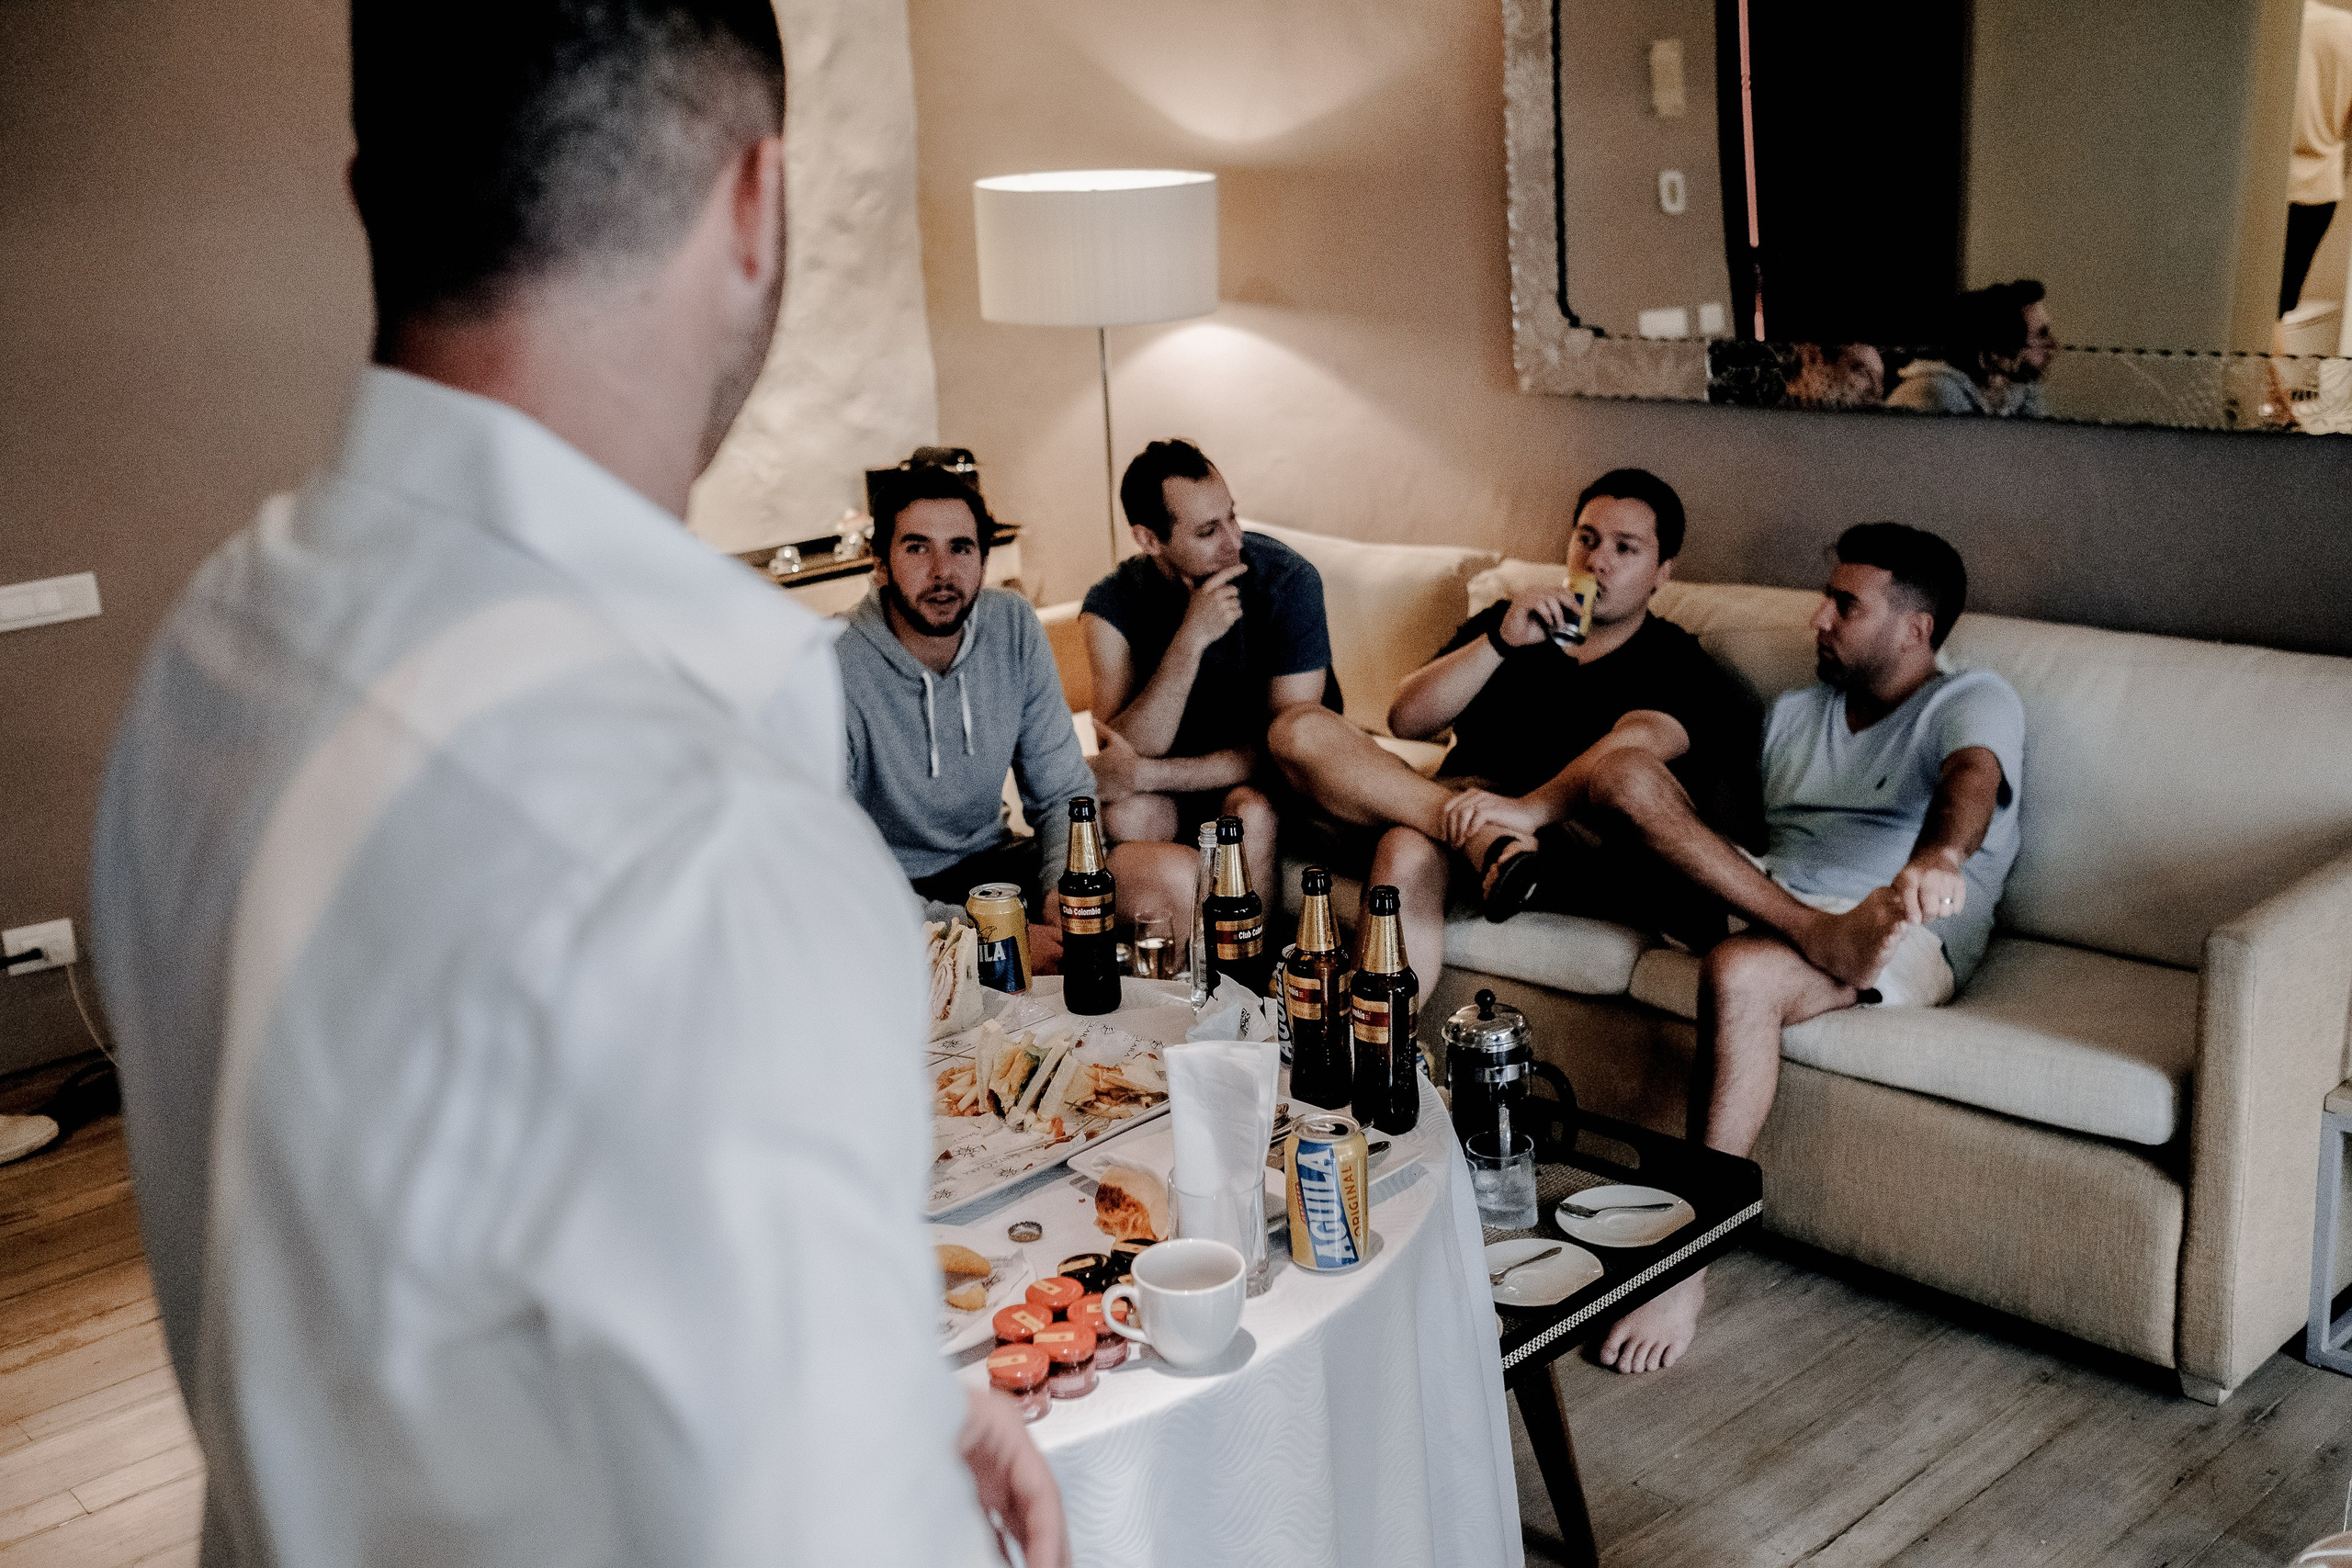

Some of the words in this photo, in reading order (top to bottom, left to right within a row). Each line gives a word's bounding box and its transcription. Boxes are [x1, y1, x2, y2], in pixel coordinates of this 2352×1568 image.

[1062, 906, 1073, 915] Club
[1074, 907, 1102, 916] Colombia
[1238, 931, 1251, 940] Club
[978, 942, 1006, 963] ILA
[1297, 1148, 1356, 1259] AGUILA
